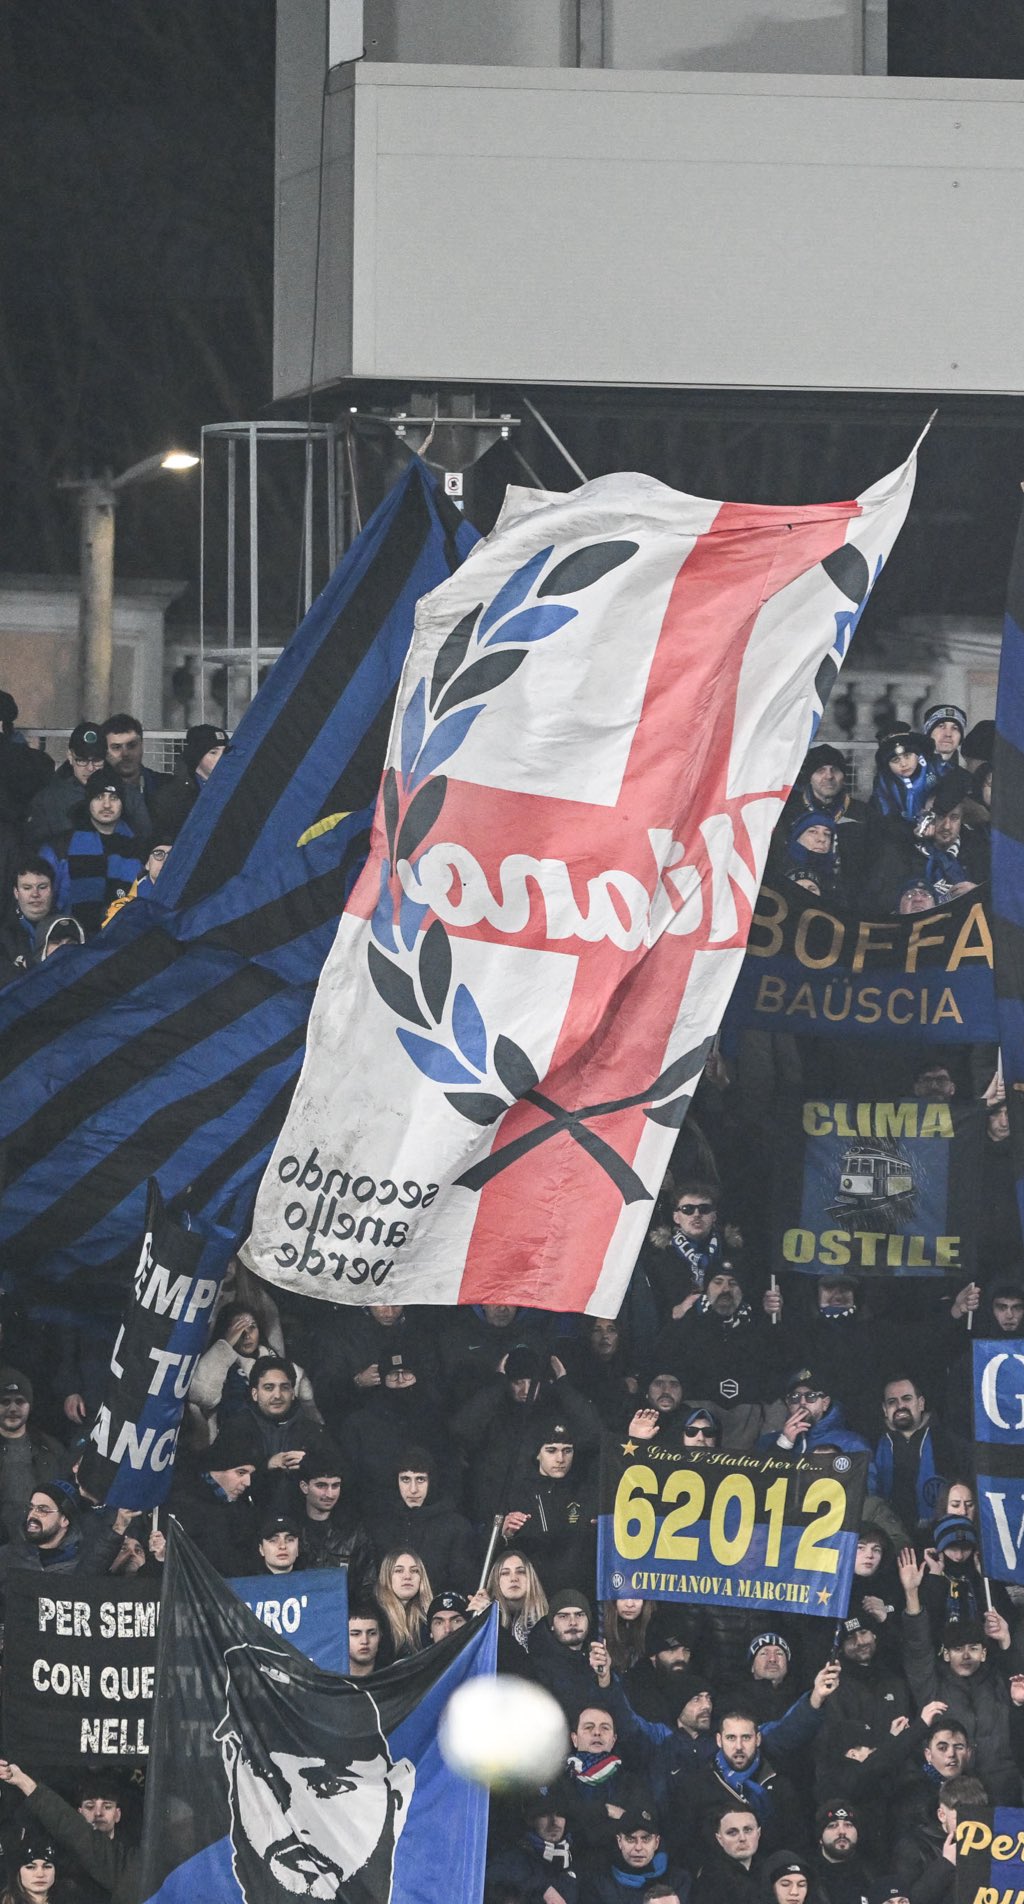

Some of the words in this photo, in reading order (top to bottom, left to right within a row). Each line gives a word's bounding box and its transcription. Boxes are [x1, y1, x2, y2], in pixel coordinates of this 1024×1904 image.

[747, 886, 994, 974] BOFFA
[755, 974, 964, 1026] BAÜSCIA
[803, 1103, 955, 1138] CLIMA
[782, 1228, 962, 1268] OSTILE
[647, 1444, 684, 1462] Giro
[760, 1456, 792, 1474] per
[613, 1464, 847, 1575] 62012
[631, 1571, 733, 1597] CIVITANOVA
[737, 1579, 811, 1604] MARCHE
[38, 1597, 92, 1638] PER
[99, 1600, 161, 1639] SEM
[32, 1658, 91, 1698] CON
[80, 1718, 150, 1755] NELL
